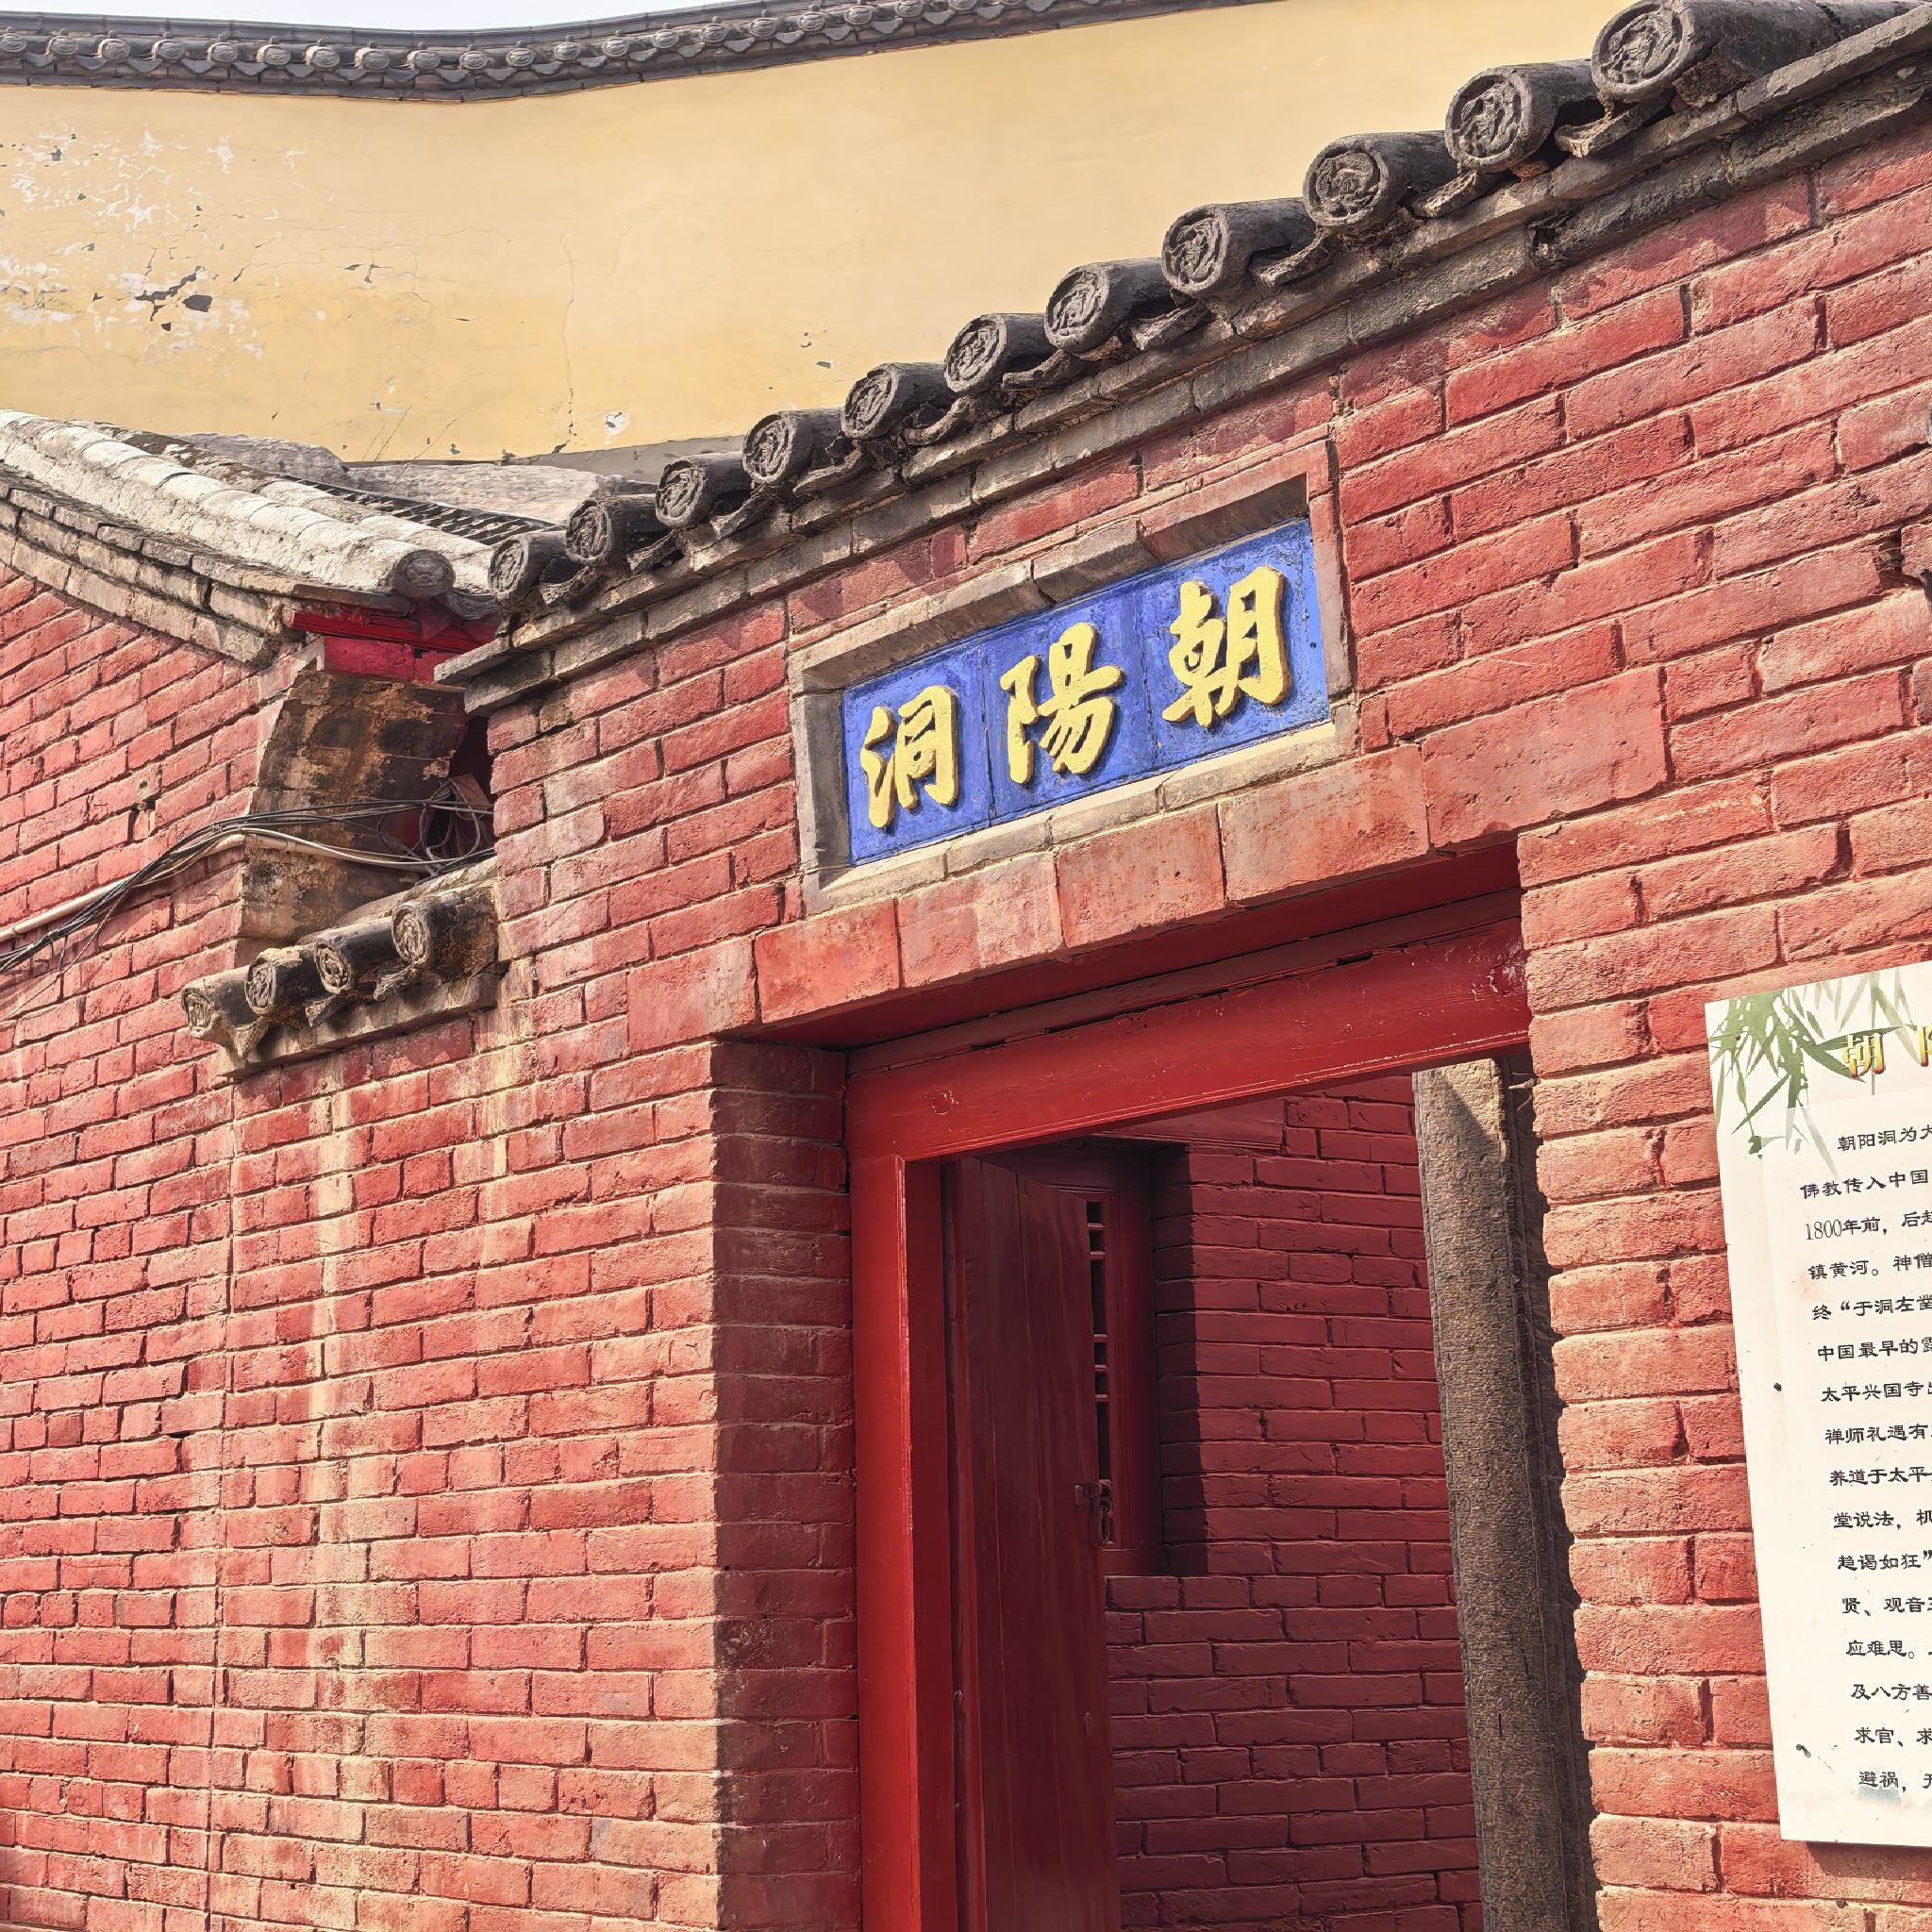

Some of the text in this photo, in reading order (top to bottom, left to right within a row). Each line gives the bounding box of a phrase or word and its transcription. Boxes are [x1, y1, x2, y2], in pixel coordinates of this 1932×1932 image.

[1821, 1380, 1932, 1403] 太平兴国寺
[1824, 1424, 1932, 1445] 禅师礼遇有
[1829, 1466, 1932, 1487] 养道于太平
[1841, 1596, 1932, 1616] 贤、观音
[1845, 1640, 1932, 1659] 应难思。
